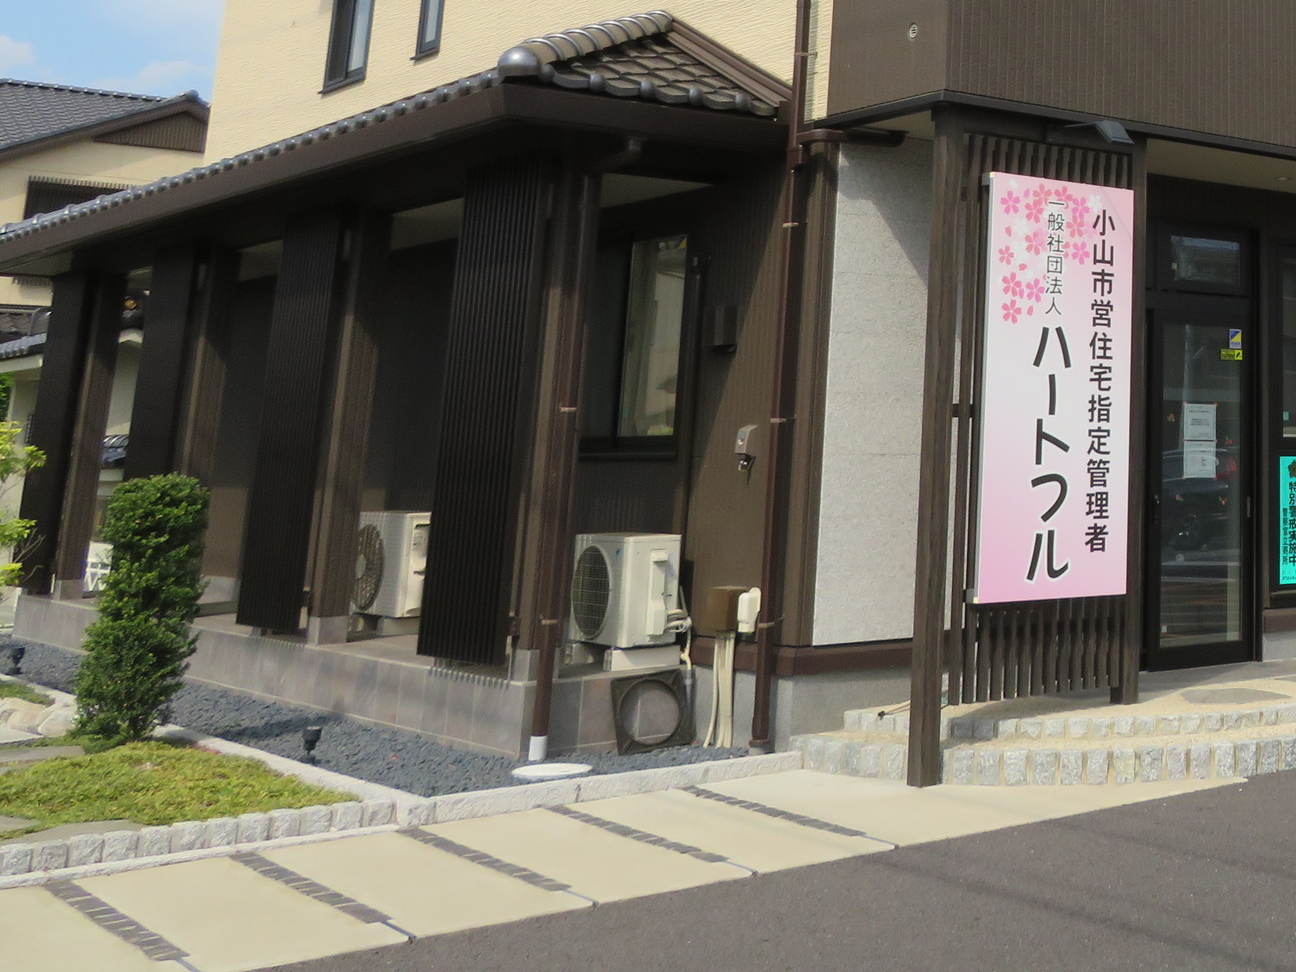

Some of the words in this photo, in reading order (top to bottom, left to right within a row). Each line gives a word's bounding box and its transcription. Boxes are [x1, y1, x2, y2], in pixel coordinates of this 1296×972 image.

[1045, 201, 1065, 316] 一般社団法人
[1085, 209, 1115, 553] 小山市営住宅指定管理者
